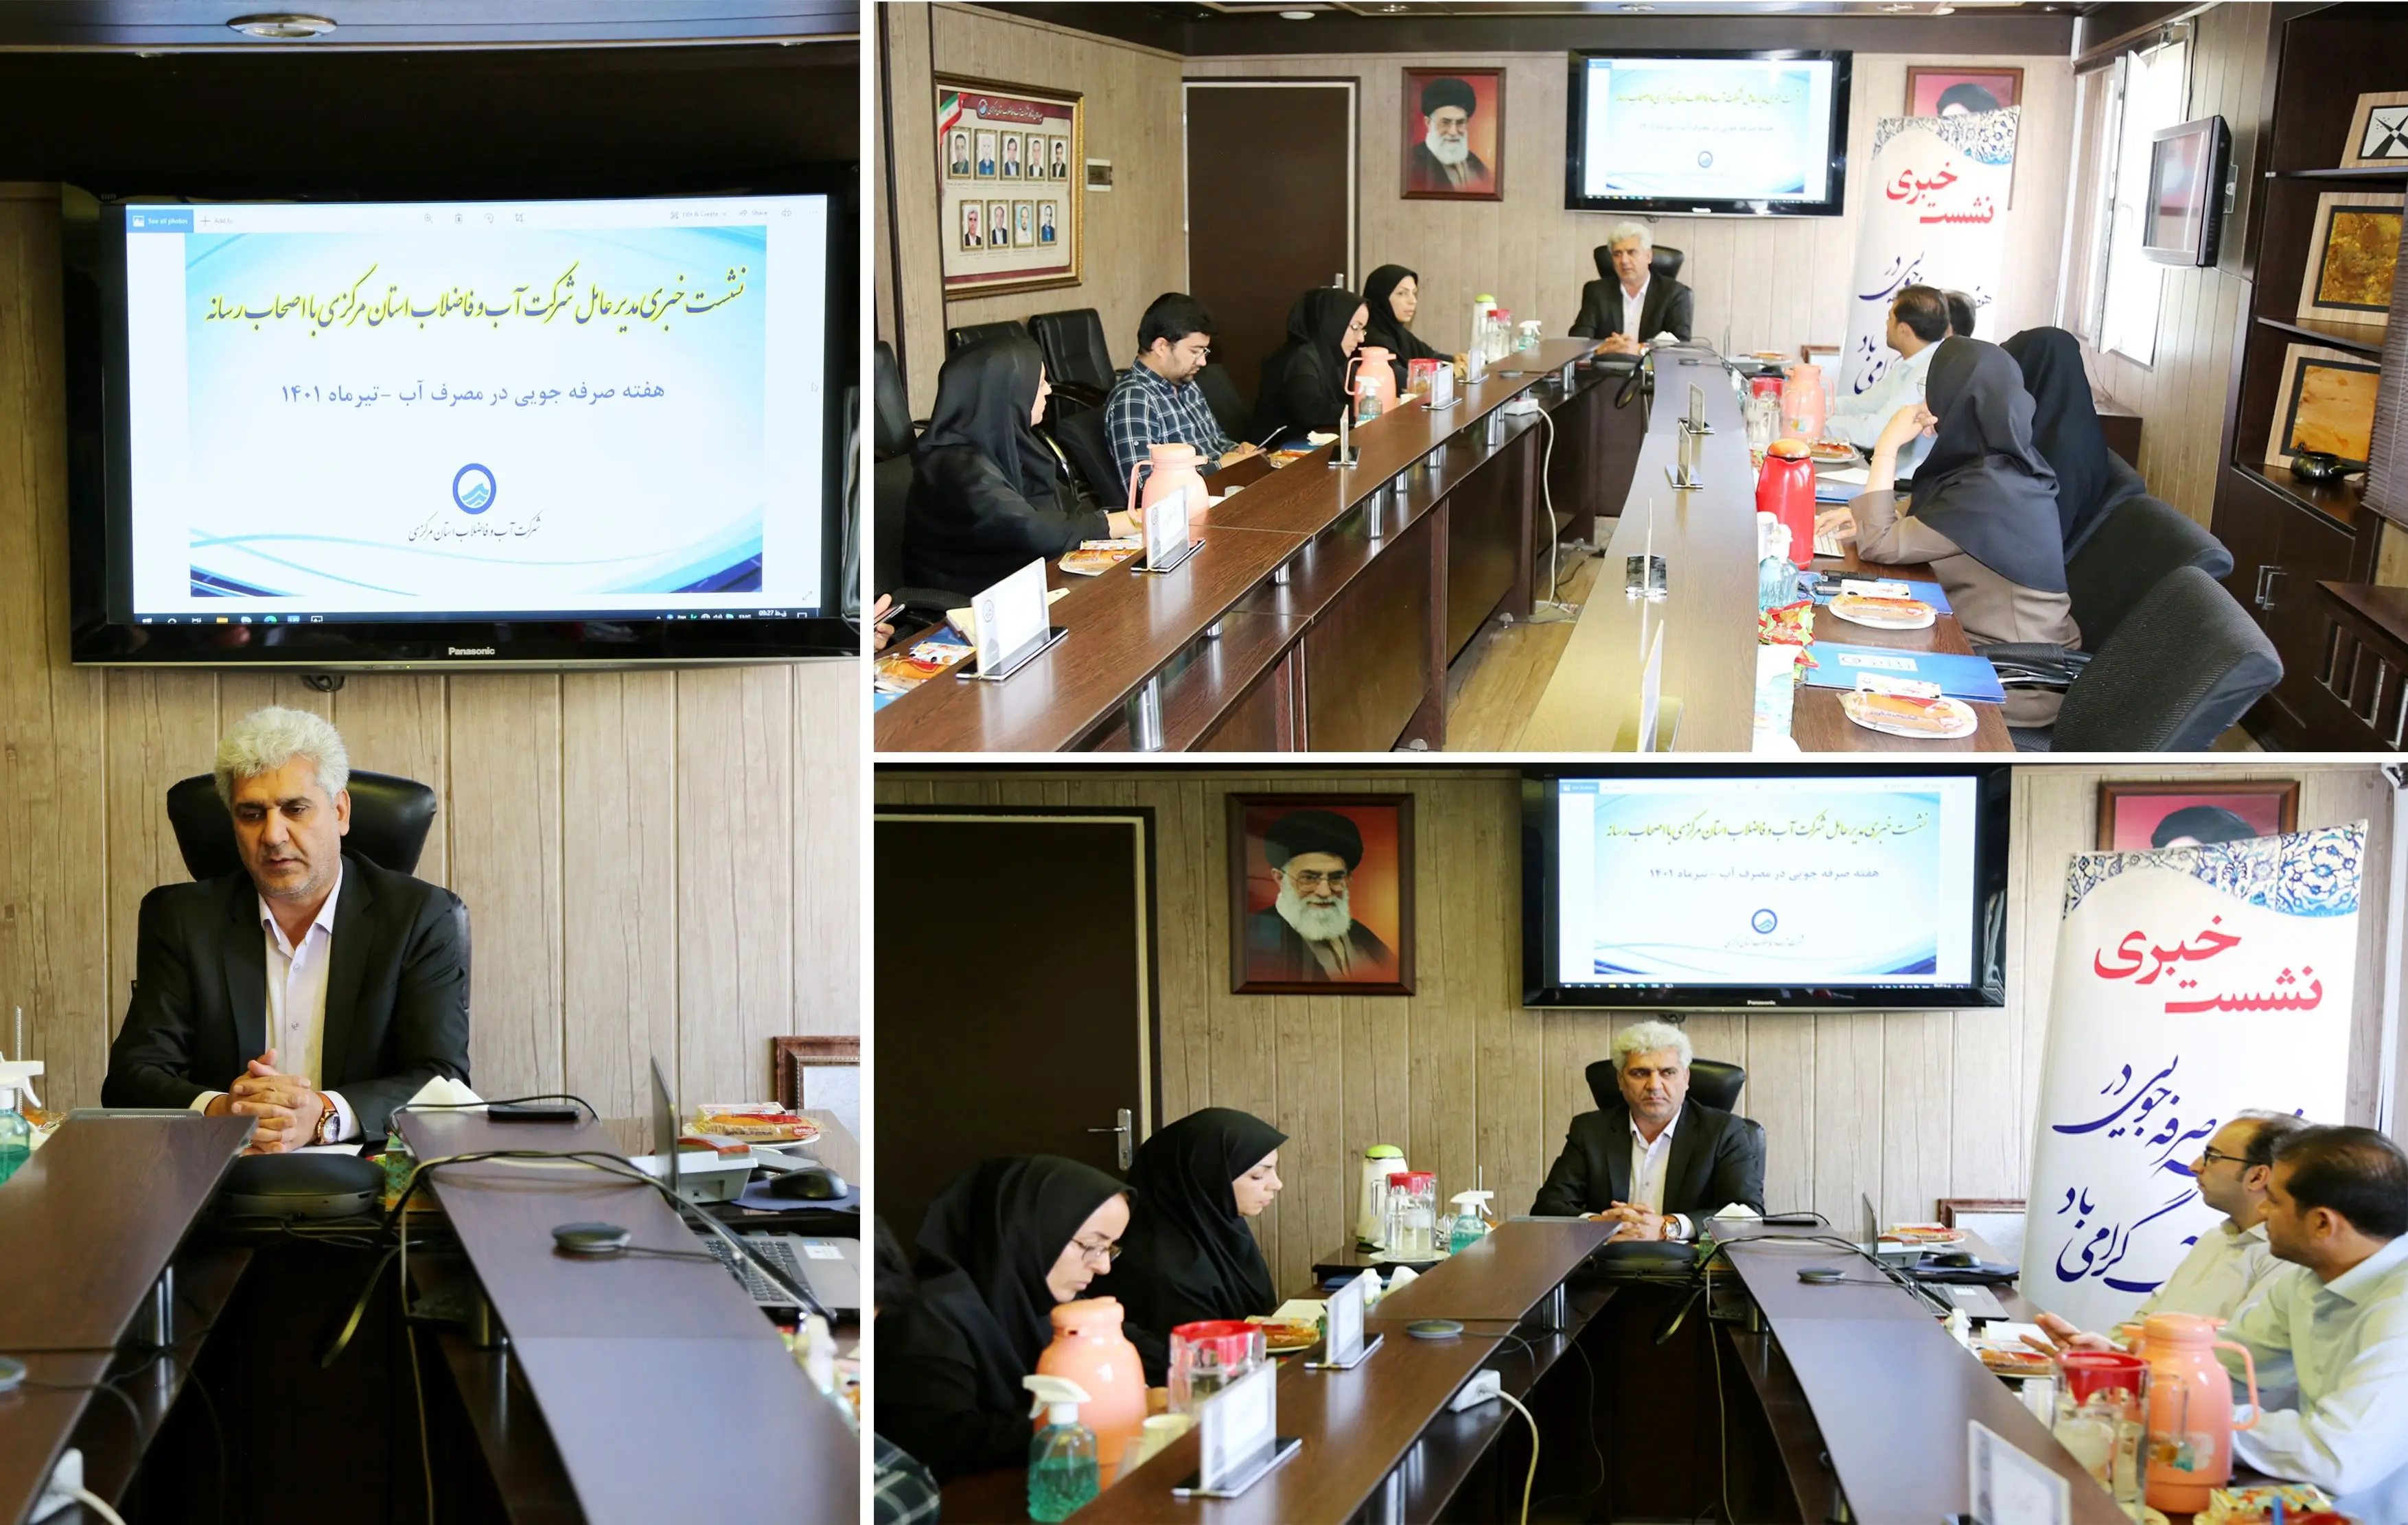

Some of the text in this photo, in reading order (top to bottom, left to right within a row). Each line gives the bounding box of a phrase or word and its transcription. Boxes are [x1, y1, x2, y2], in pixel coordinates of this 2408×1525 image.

[1886, 162, 1994, 224] نشست خبری
[167, 217, 188, 225] photos
[317, 263, 378, 328] مرکزی
[524, 261, 579, 324] شرکت
[640, 275, 684, 332] خبری
[686, 266, 746, 314] نشست
[205, 295, 243, 321] رسانه
[244, 295, 306, 331] اصحاب
[367, 285, 409, 327] استان
[410, 287, 474, 329] فاضلاب
[475, 301, 484, 318] و
[485, 285, 529, 329] آب
[281, 385, 320, 403] ۱۴۰۱
[399, 379, 424, 406] آب
[431, 383, 484, 407] مصرف
[489, 388, 508, 406] در
[514, 388, 562, 408] جویی
[568, 381, 616, 406] صرفه
[622, 380, 665, 398] هفته
[456, 522, 489, 542] فاضلاب
[494, 521, 516, 542] آب
[514, 509, 543, 539] شرکت
[448, 647, 496, 656] Panasonic
[1795, 808, 1829, 840] شرکت
[2094, 914, 2323, 1014] نشست خبری
[2100, 1063, 2132, 1096] در
[2056, 1186, 2199, 1283] گرامی باد
